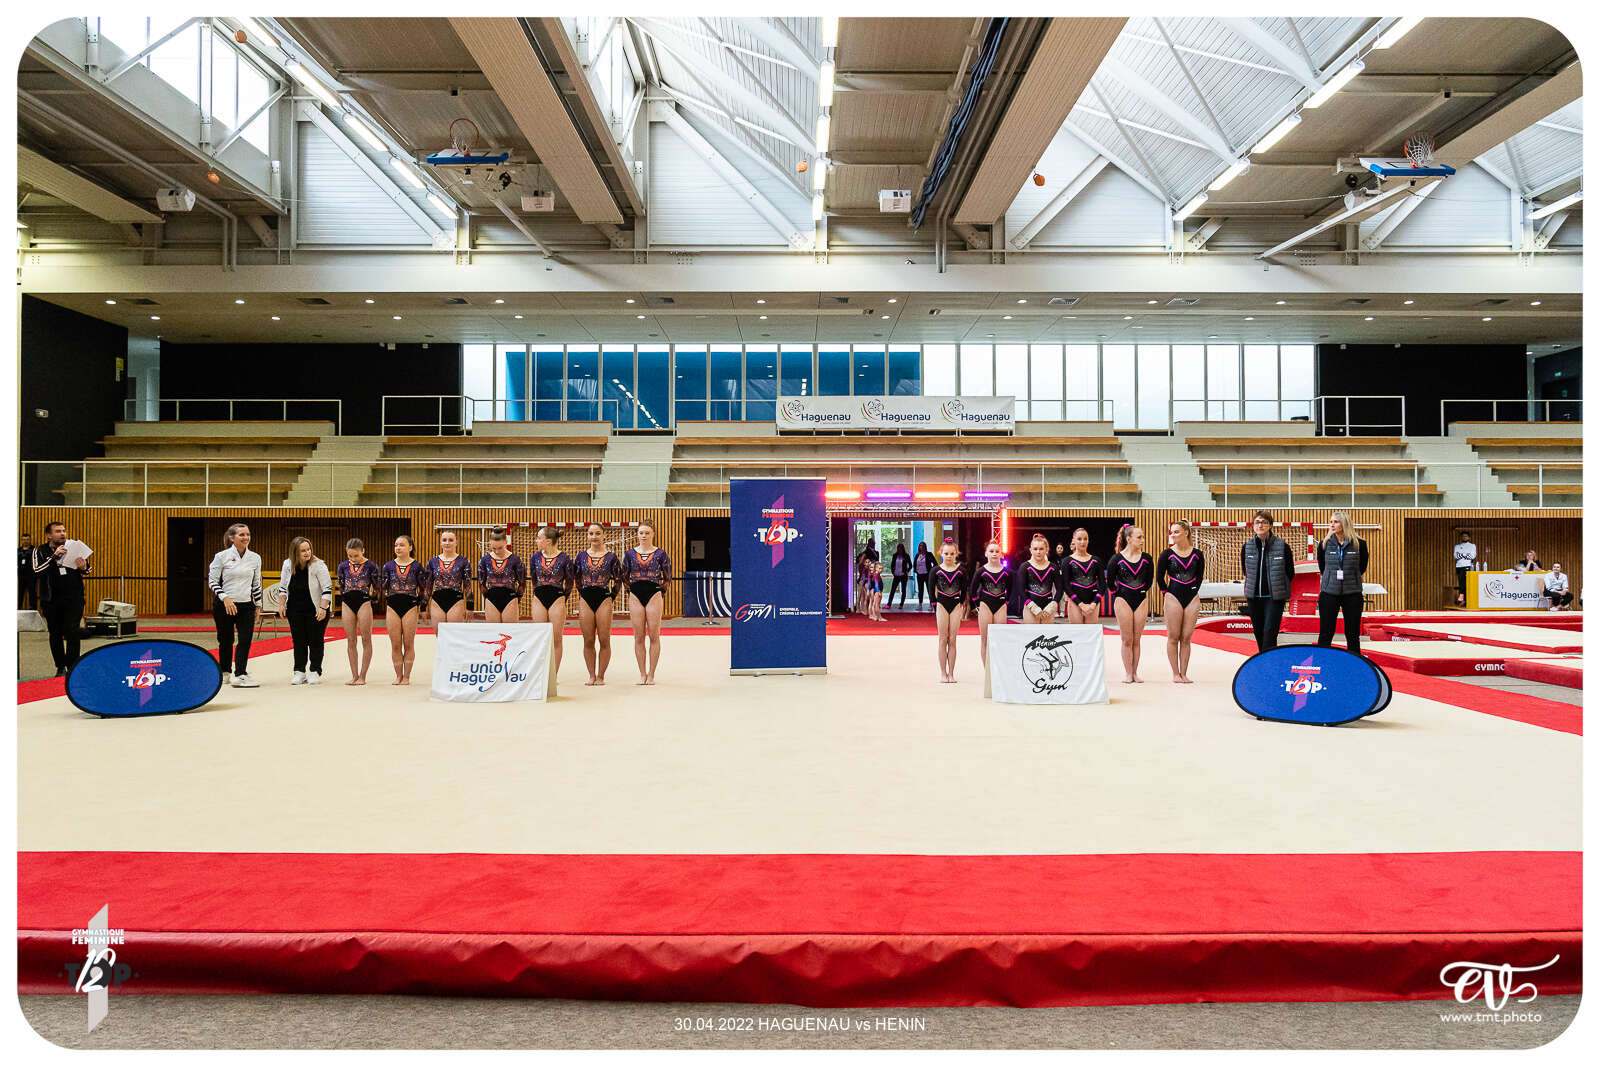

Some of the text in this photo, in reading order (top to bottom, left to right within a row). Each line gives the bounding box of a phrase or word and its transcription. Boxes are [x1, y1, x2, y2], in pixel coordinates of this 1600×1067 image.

[801, 413, 851, 423] Haguenau
[881, 413, 931, 423] Haguenau
[961, 413, 1010, 423] Haguenau
[757, 525, 799, 543] TOP
[1500, 591, 1540, 600] Haguena
[125, 673, 167, 688] TOP
[1032, 678, 1068, 695] Gym
[1284, 679, 1323, 694] TOP
